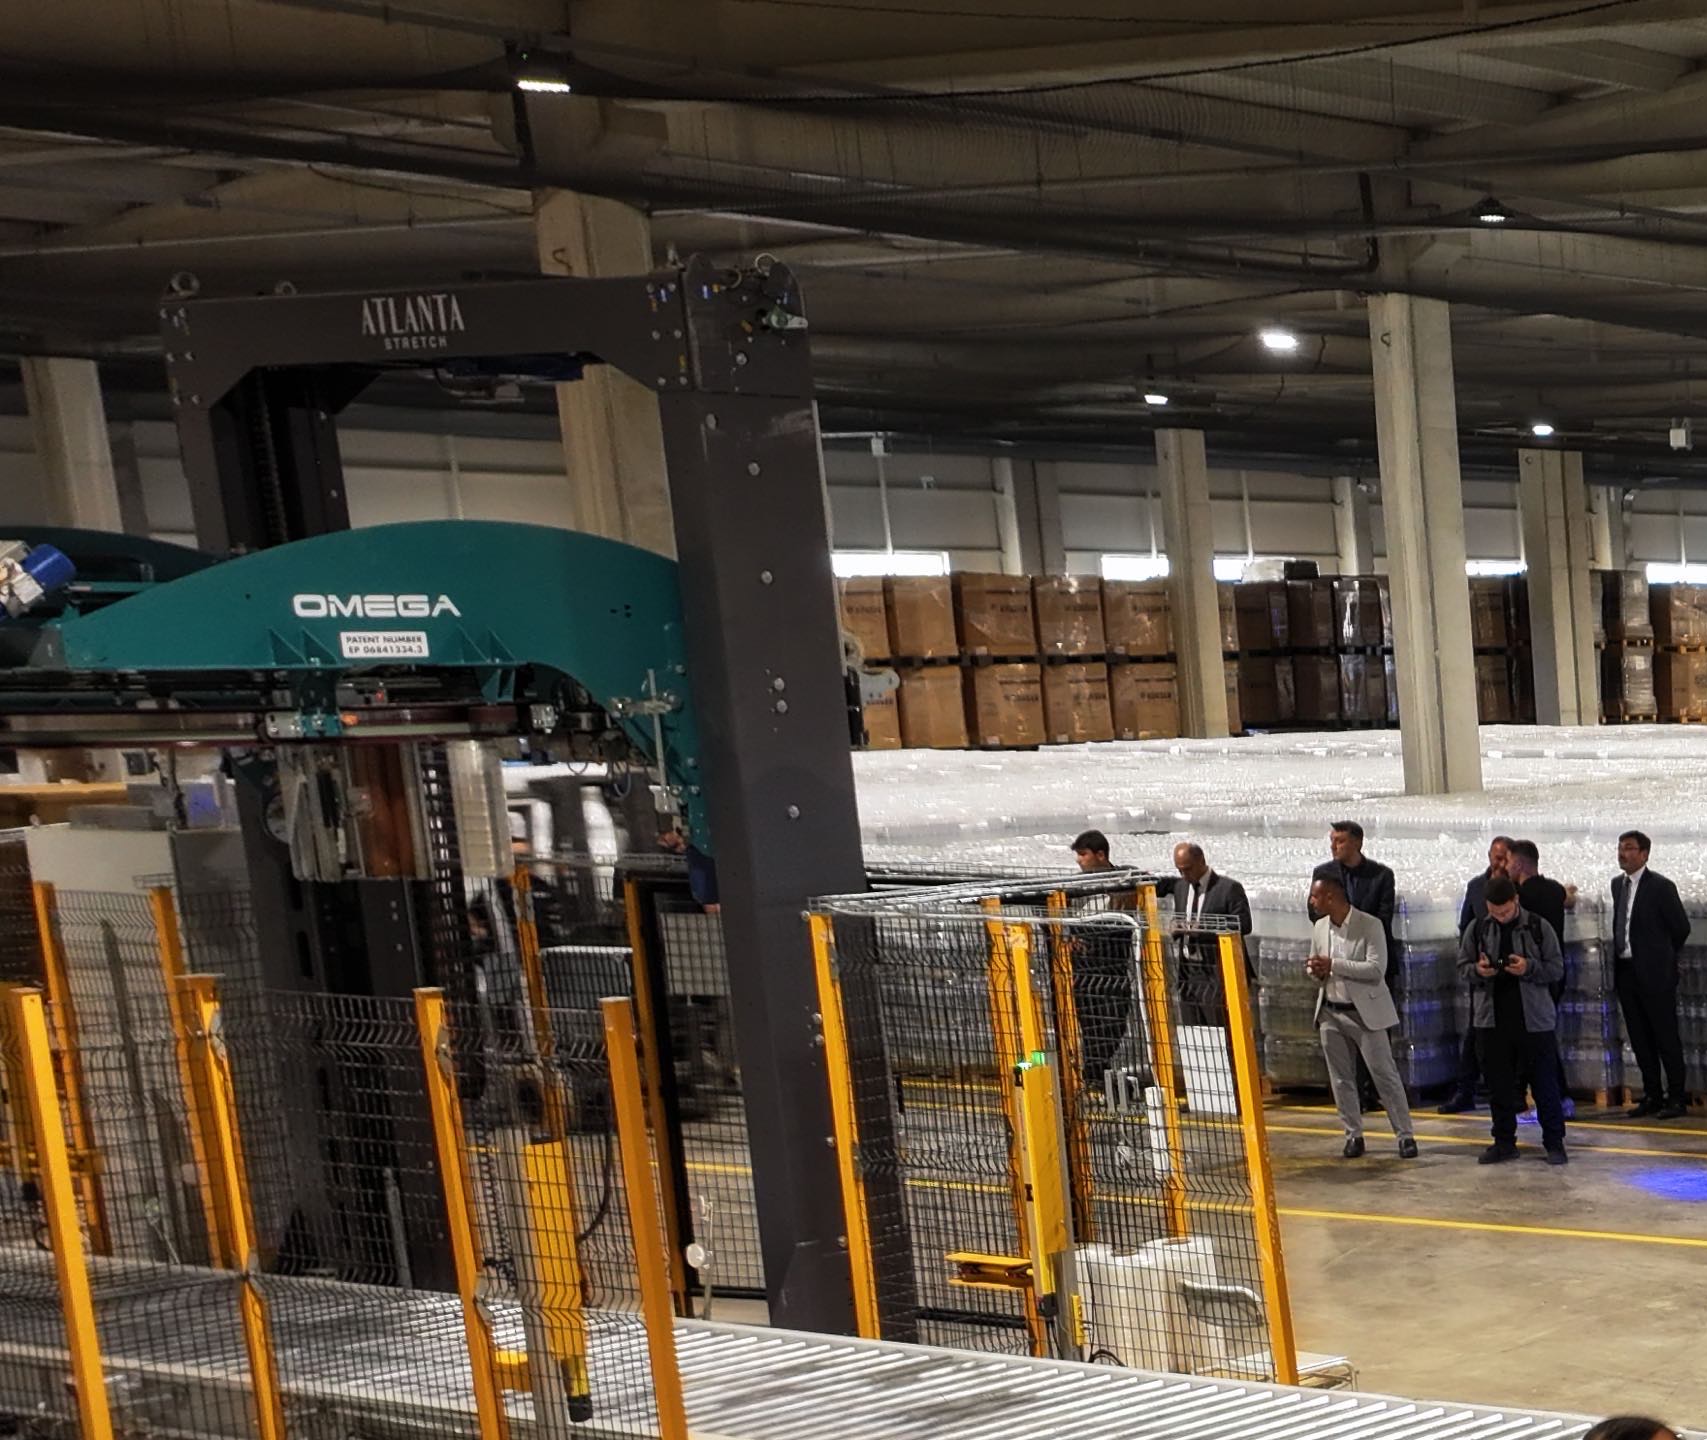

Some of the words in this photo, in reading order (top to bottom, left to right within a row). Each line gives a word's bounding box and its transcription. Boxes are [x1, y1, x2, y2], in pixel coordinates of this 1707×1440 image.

[362, 294, 465, 335] ATLANTA
[384, 336, 448, 350] STRETCH
[293, 594, 462, 618] OMEGA
